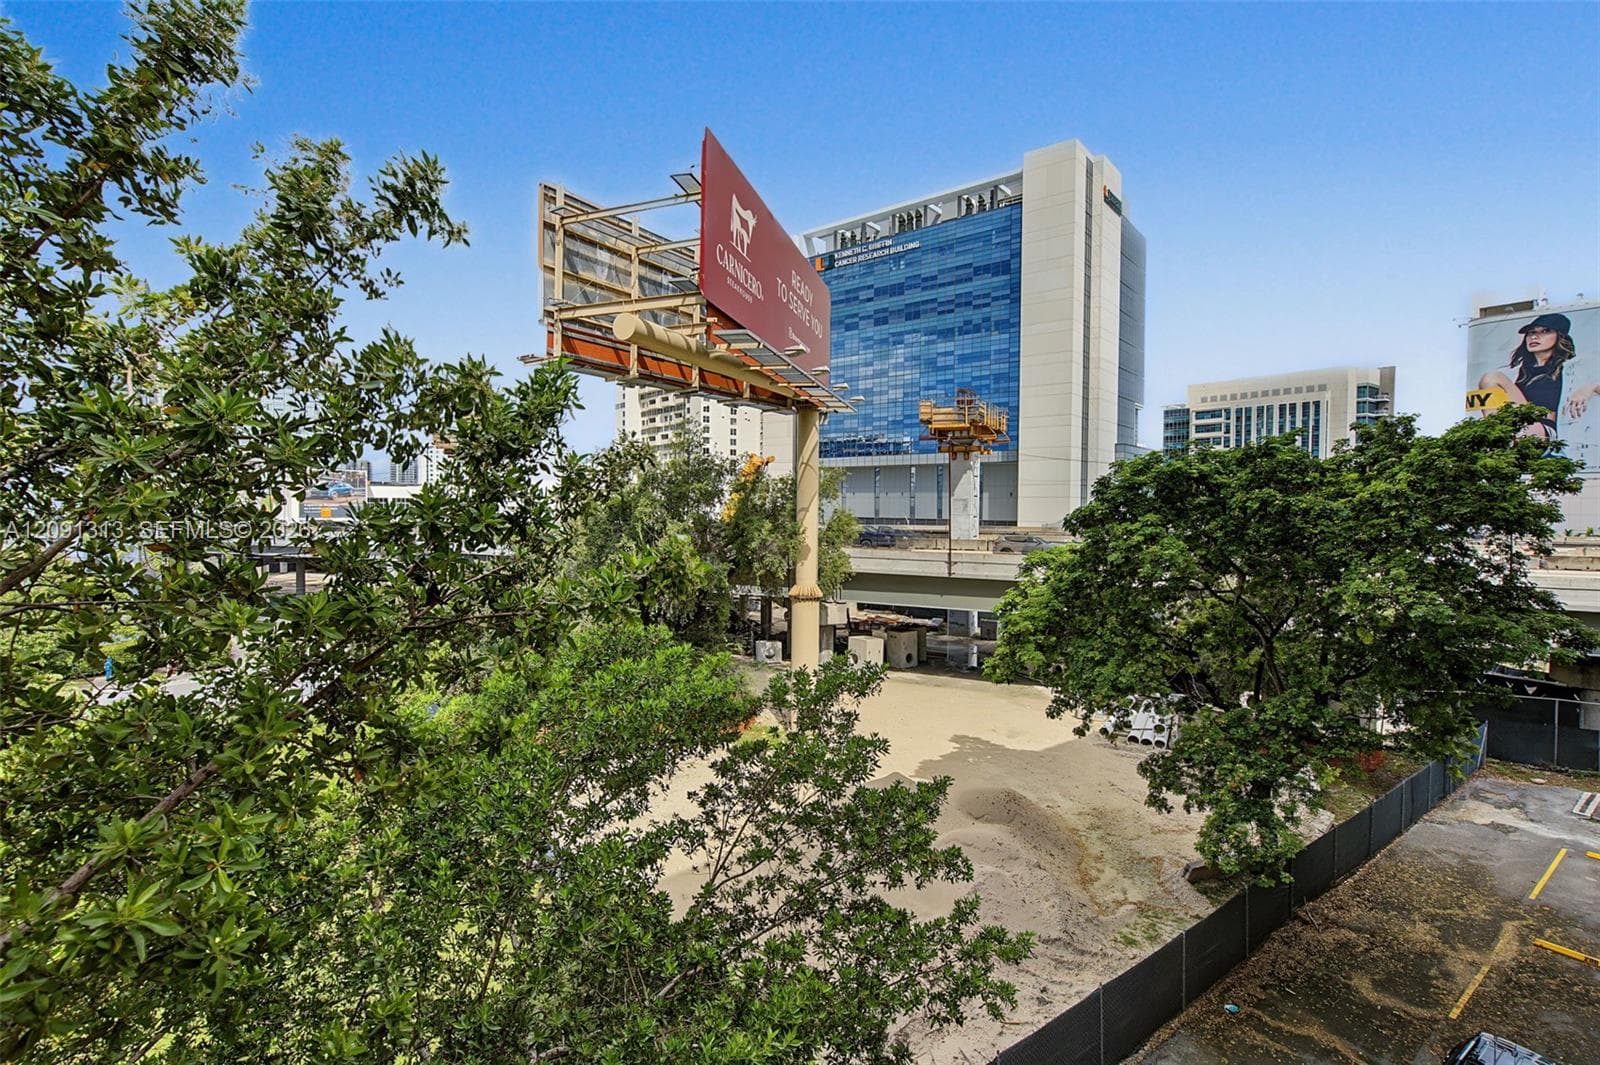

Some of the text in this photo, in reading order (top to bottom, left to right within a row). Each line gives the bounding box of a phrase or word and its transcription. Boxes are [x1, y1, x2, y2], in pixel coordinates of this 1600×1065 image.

[716, 243, 763, 300] CARNICERO
[834, 240, 920, 268] CANCER RESEARCH BUILDING
[776, 276, 788, 303] TO
[788, 291, 810, 328] SERVE
[811, 314, 823, 339] YOU
[791, 269, 814, 307] READY
